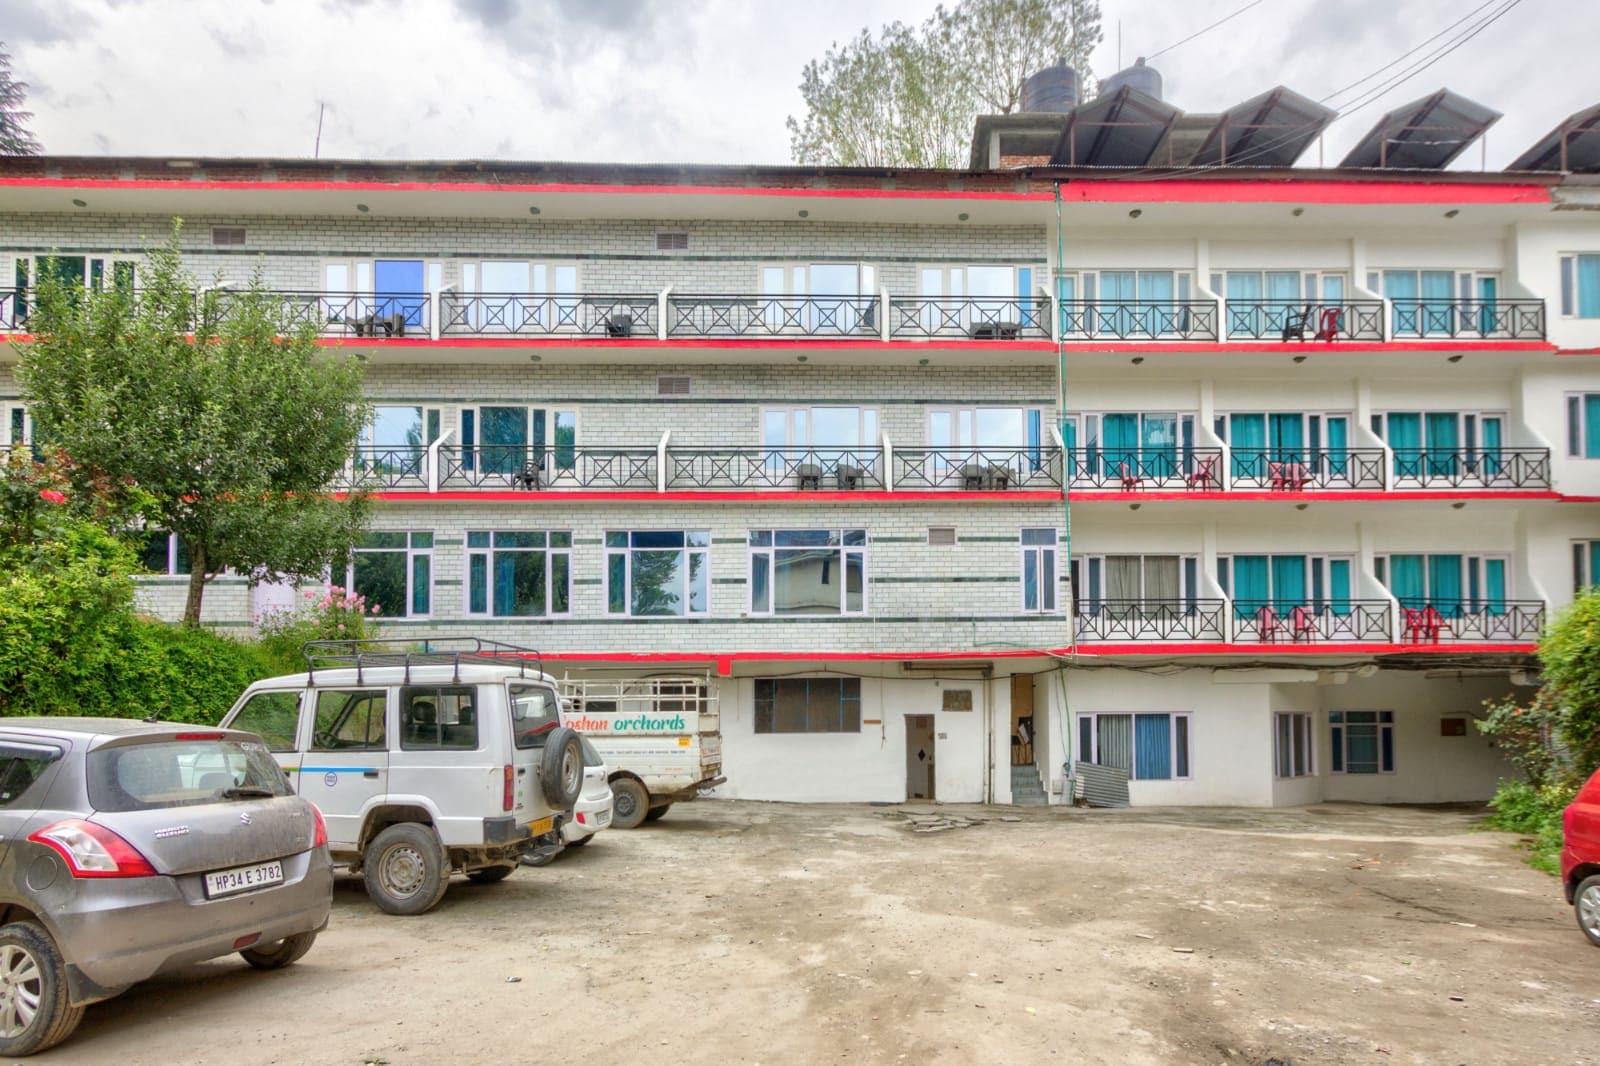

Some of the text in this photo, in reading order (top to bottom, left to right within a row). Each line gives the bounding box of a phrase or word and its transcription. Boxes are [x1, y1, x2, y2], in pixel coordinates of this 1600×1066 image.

[564, 714, 686, 731] oshan orchards
[216, 865, 281, 890] HP34 E 3782
